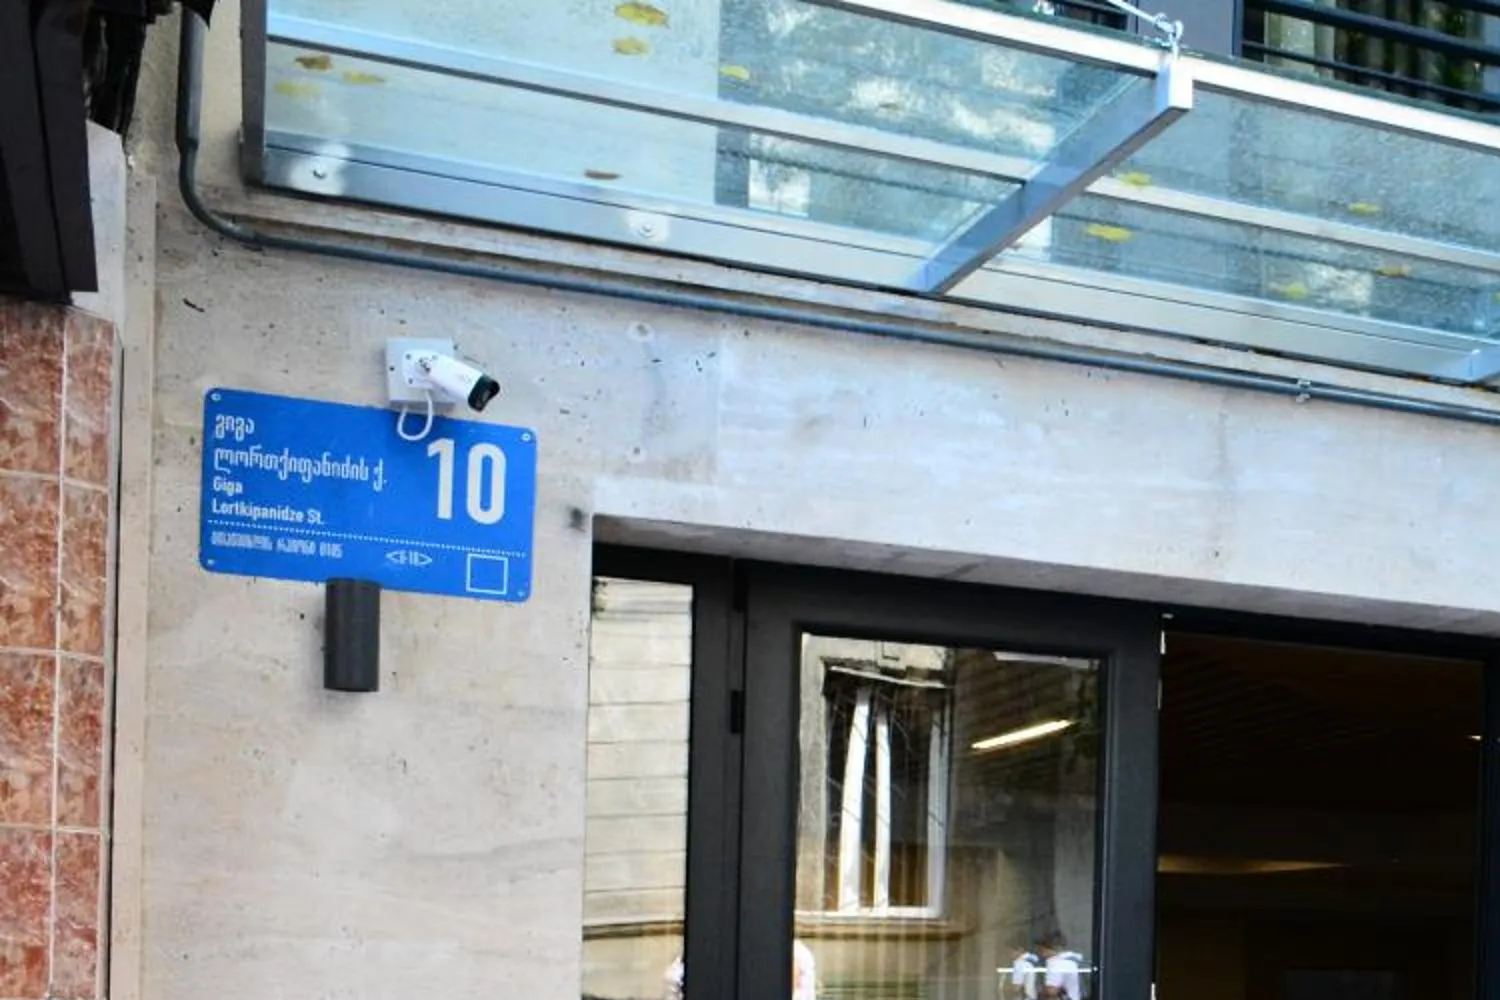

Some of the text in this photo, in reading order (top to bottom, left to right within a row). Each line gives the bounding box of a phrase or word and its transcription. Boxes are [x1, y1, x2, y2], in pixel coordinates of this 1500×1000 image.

[215, 413, 255, 442] გიგა
[213, 476, 243, 496] Giga
[427, 438, 506, 524] 10
